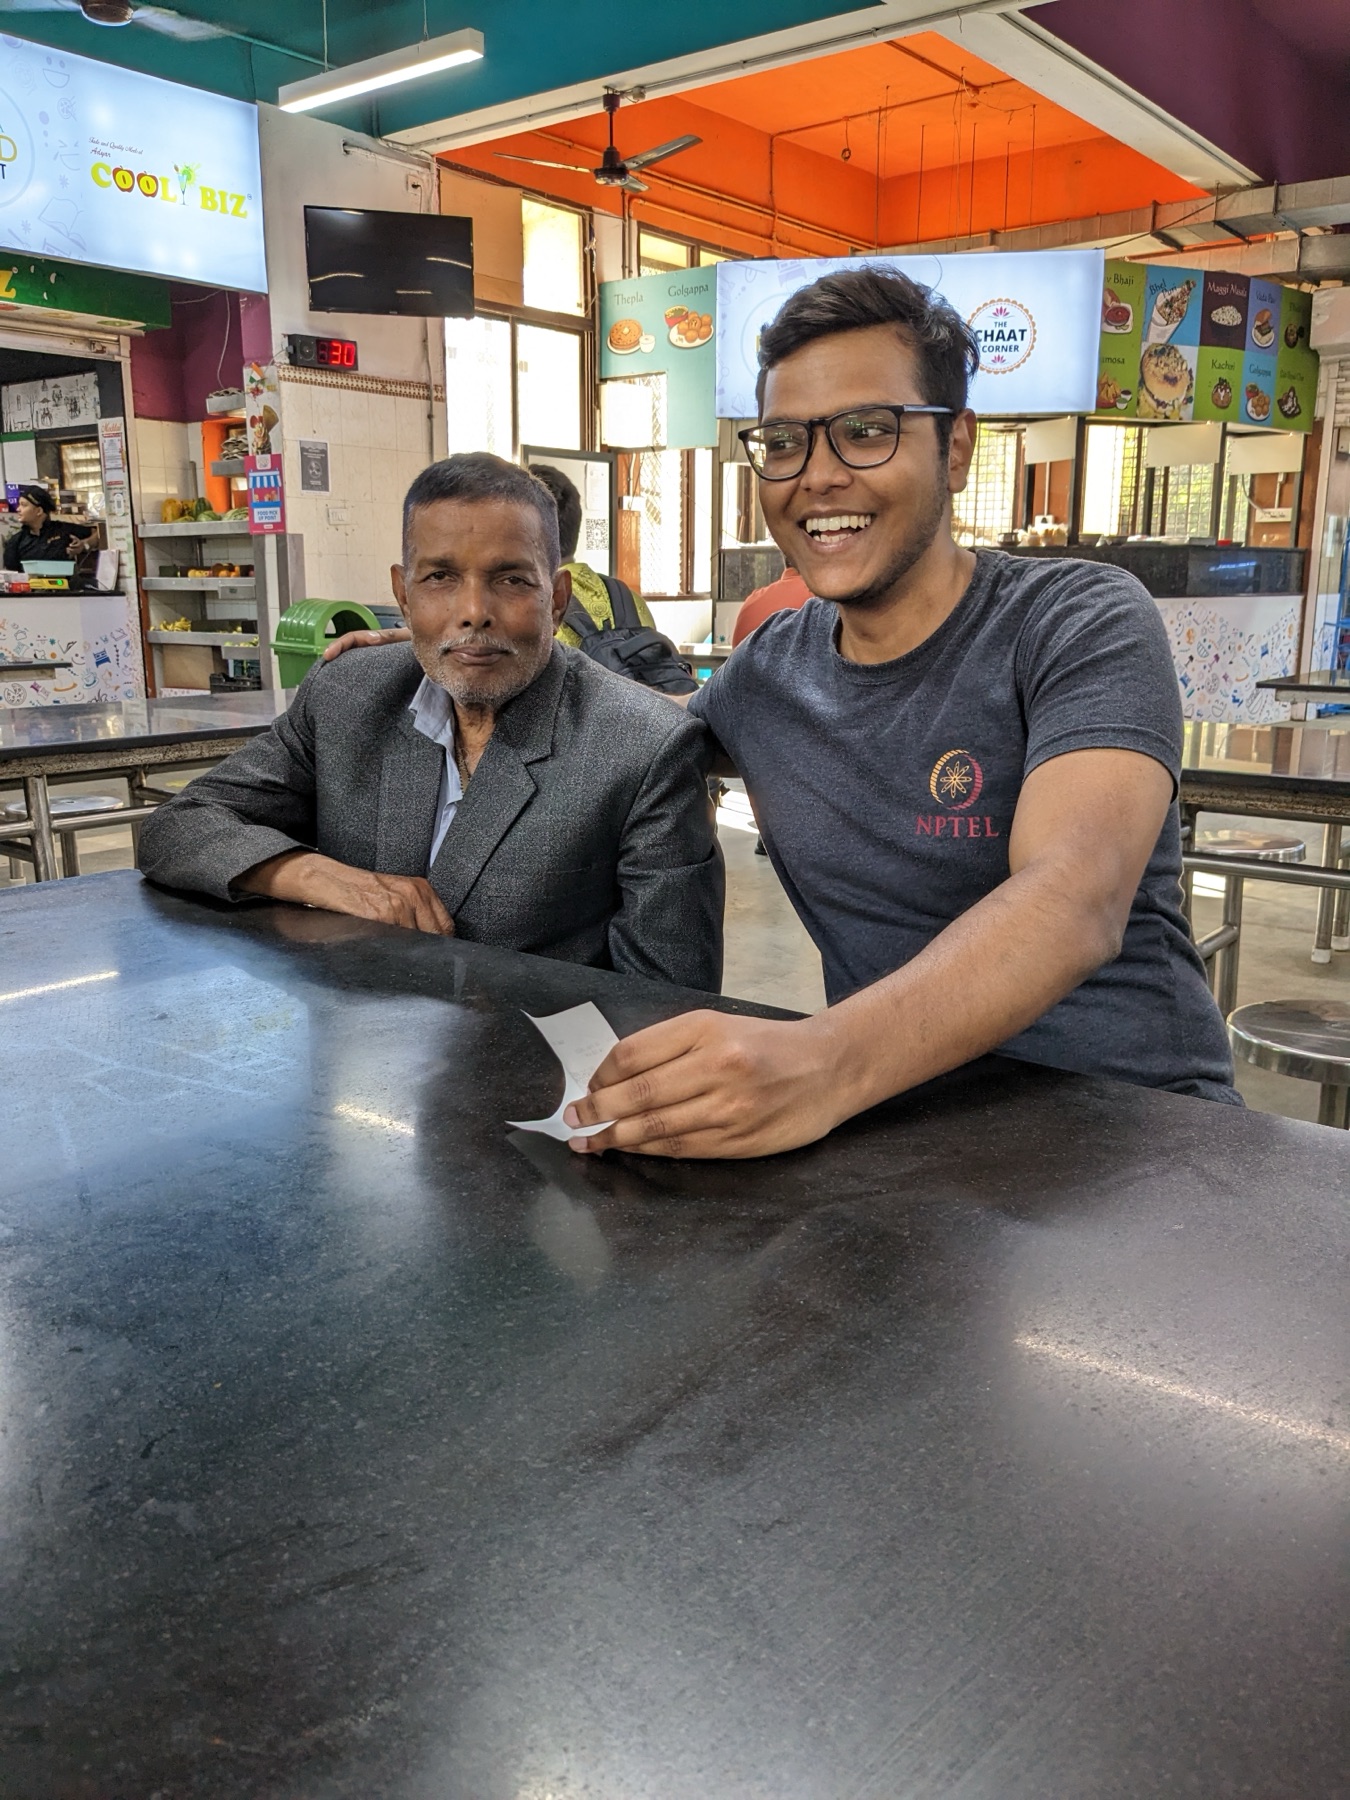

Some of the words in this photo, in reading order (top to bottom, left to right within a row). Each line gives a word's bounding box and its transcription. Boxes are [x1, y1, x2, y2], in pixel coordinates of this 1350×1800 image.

[90, 161, 178, 203] COOL
[199, 185, 248, 219] BIZ
[1113, 273, 1134, 286] Bhaji
[1149, 278, 1167, 296] Bhel
[667, 284, 709, 297] Golgappa
[1206, 281, 1229, 296] Maggi
[614, 291, 644, 306] Thepla
[975, 329, 1027, 342] CHAAT
[981, 344, 1020, 353] CORNER
[915, 815, 999, 838] NPTEL
